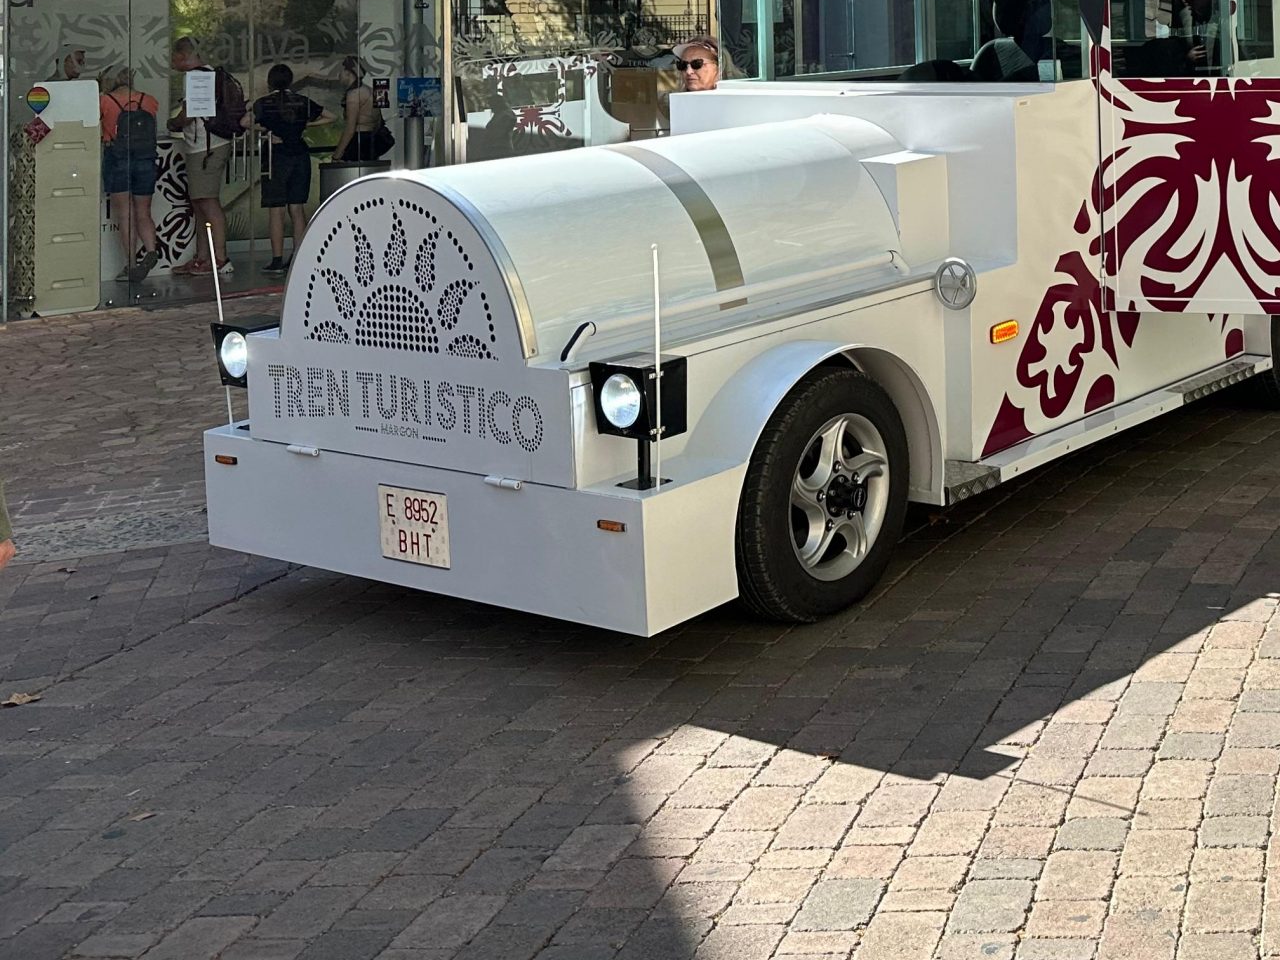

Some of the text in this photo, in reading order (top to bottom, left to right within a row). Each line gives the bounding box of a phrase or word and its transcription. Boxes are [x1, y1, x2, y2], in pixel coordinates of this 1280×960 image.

[267, 364, 544, 453] TREN TURISTICO
[385, 493, 439, 526] E 8952
[398, 528, 432, 559] BHT
